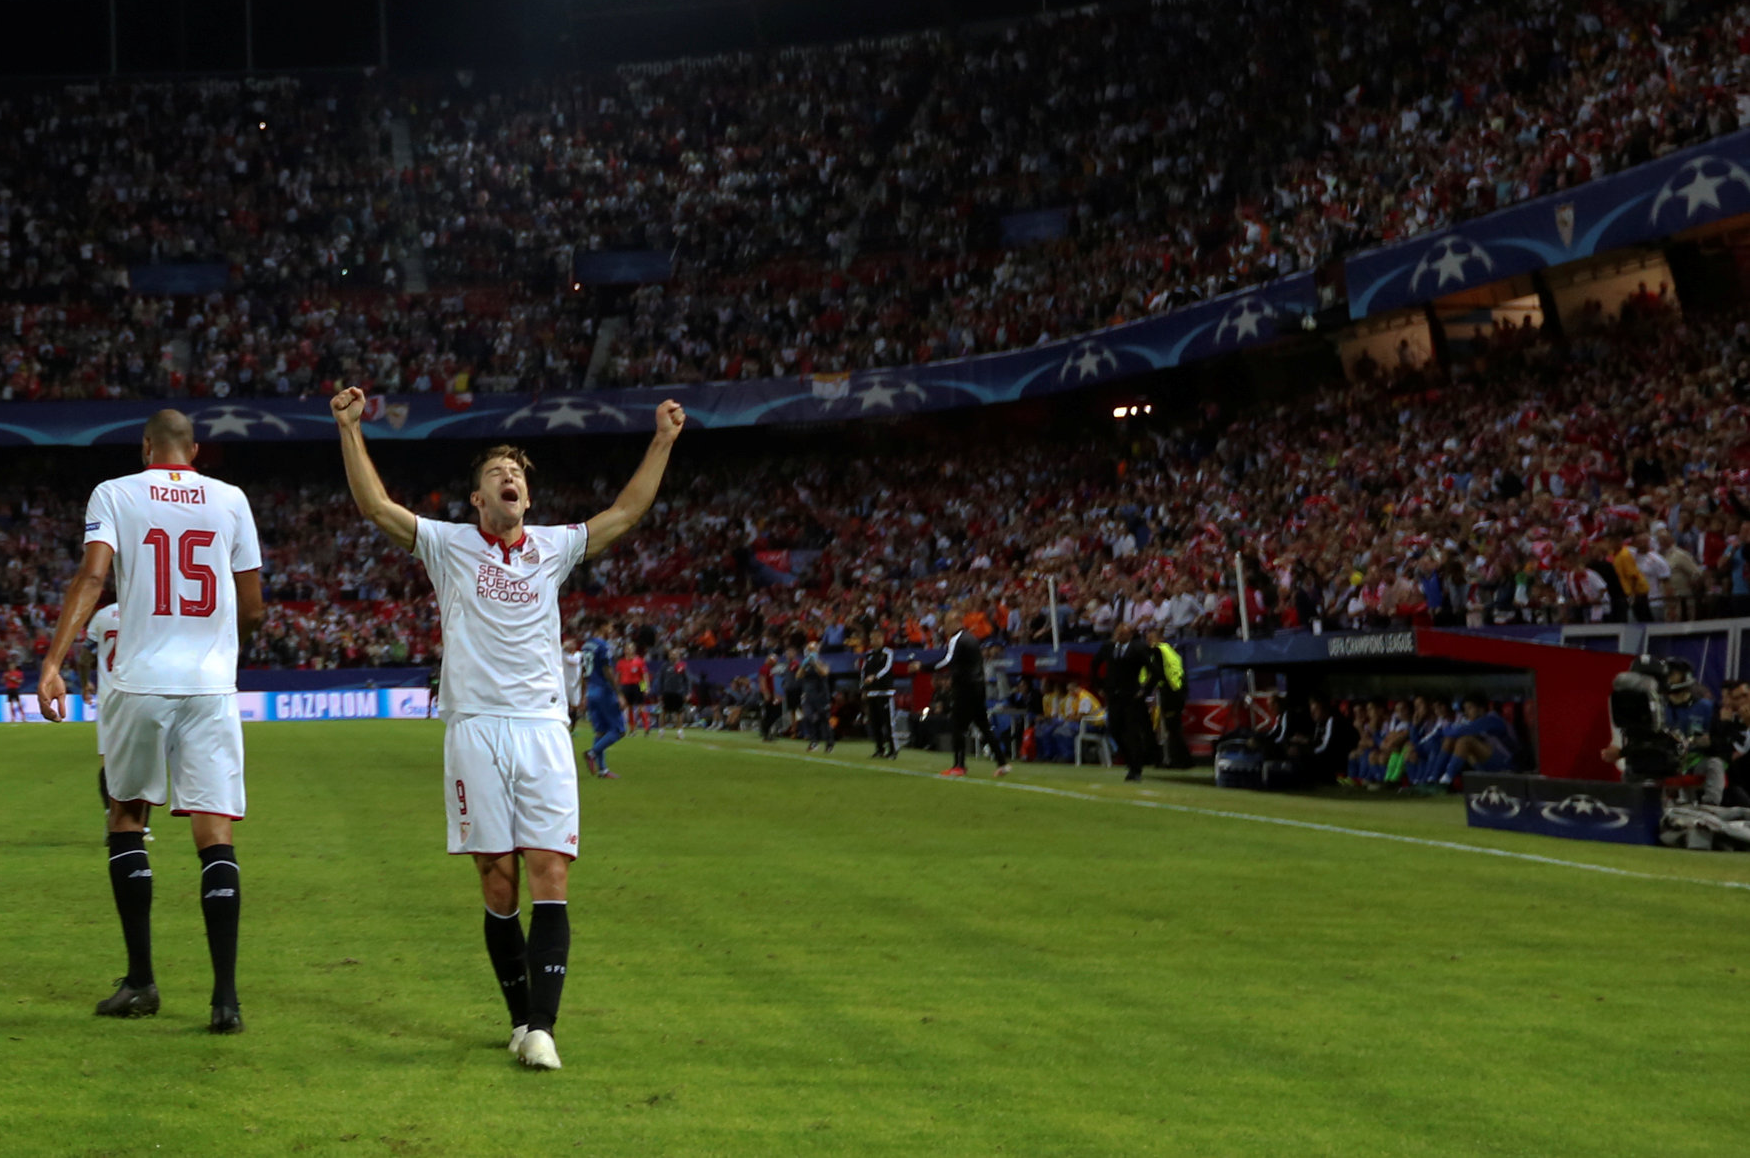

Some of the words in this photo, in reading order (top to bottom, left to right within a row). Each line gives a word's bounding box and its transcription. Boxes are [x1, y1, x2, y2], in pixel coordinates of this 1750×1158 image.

[142, 528, 217, 617] 15
[477, 575, 529, 591] PUERTO
[478, 565, 504, 577] SEE
[276, 691, 379, 719] GAZPROM
[456, 779, 467, 815] 9
